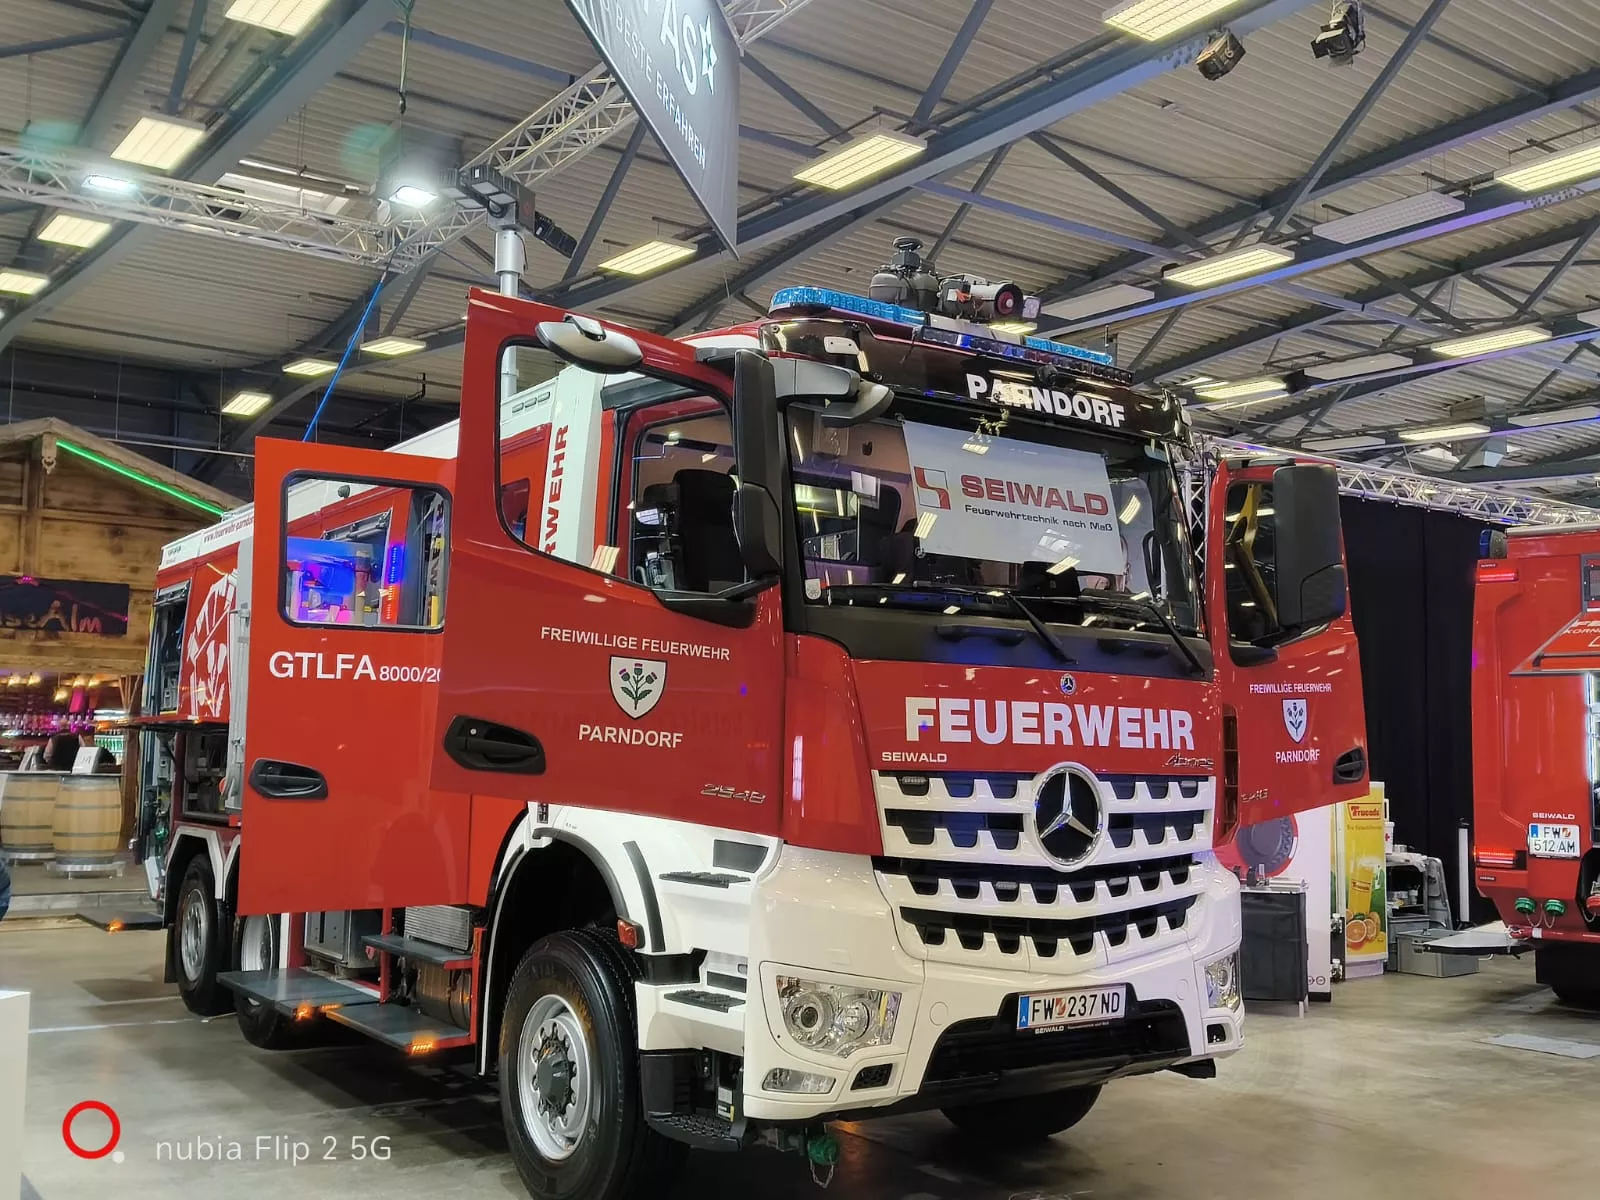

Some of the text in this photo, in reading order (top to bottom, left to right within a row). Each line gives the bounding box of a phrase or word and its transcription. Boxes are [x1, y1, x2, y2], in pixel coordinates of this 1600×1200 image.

[615, 6, 706, 169] BESTE ERFAHREN
[966, 374, 1125, 428] PARNDORF
[961, 474, 1109, 516] SEIWALD
[965, 504, 1113, 532] Feuerwehrtechnik nach Maß
[541, 626, 730, 661] FREIWILLIGE FEUERWEHR
[269, 651, 377, 681] GTLFA
[1249, 682, 1332, 694] FREIWILLIGE FEUERWEHR
[577, 724, 683, 749] PARNDORF
[905, 696, 1194, 750] FEUERWEHR
[882, 752, 947, 763] SEIWALD
[1275, 749, 1320, 763] PARNDORF
[1532, 812, 1575, 820] SEIWALD
[1534, 840, 1575, 853] 512 AM
[1543, 826, 1561, 839] FW
[1032, 998, 1055, 1021] FW
[1068, 994, 1097, 1018] 237
[1101, 992, 1120, 1014] ND
